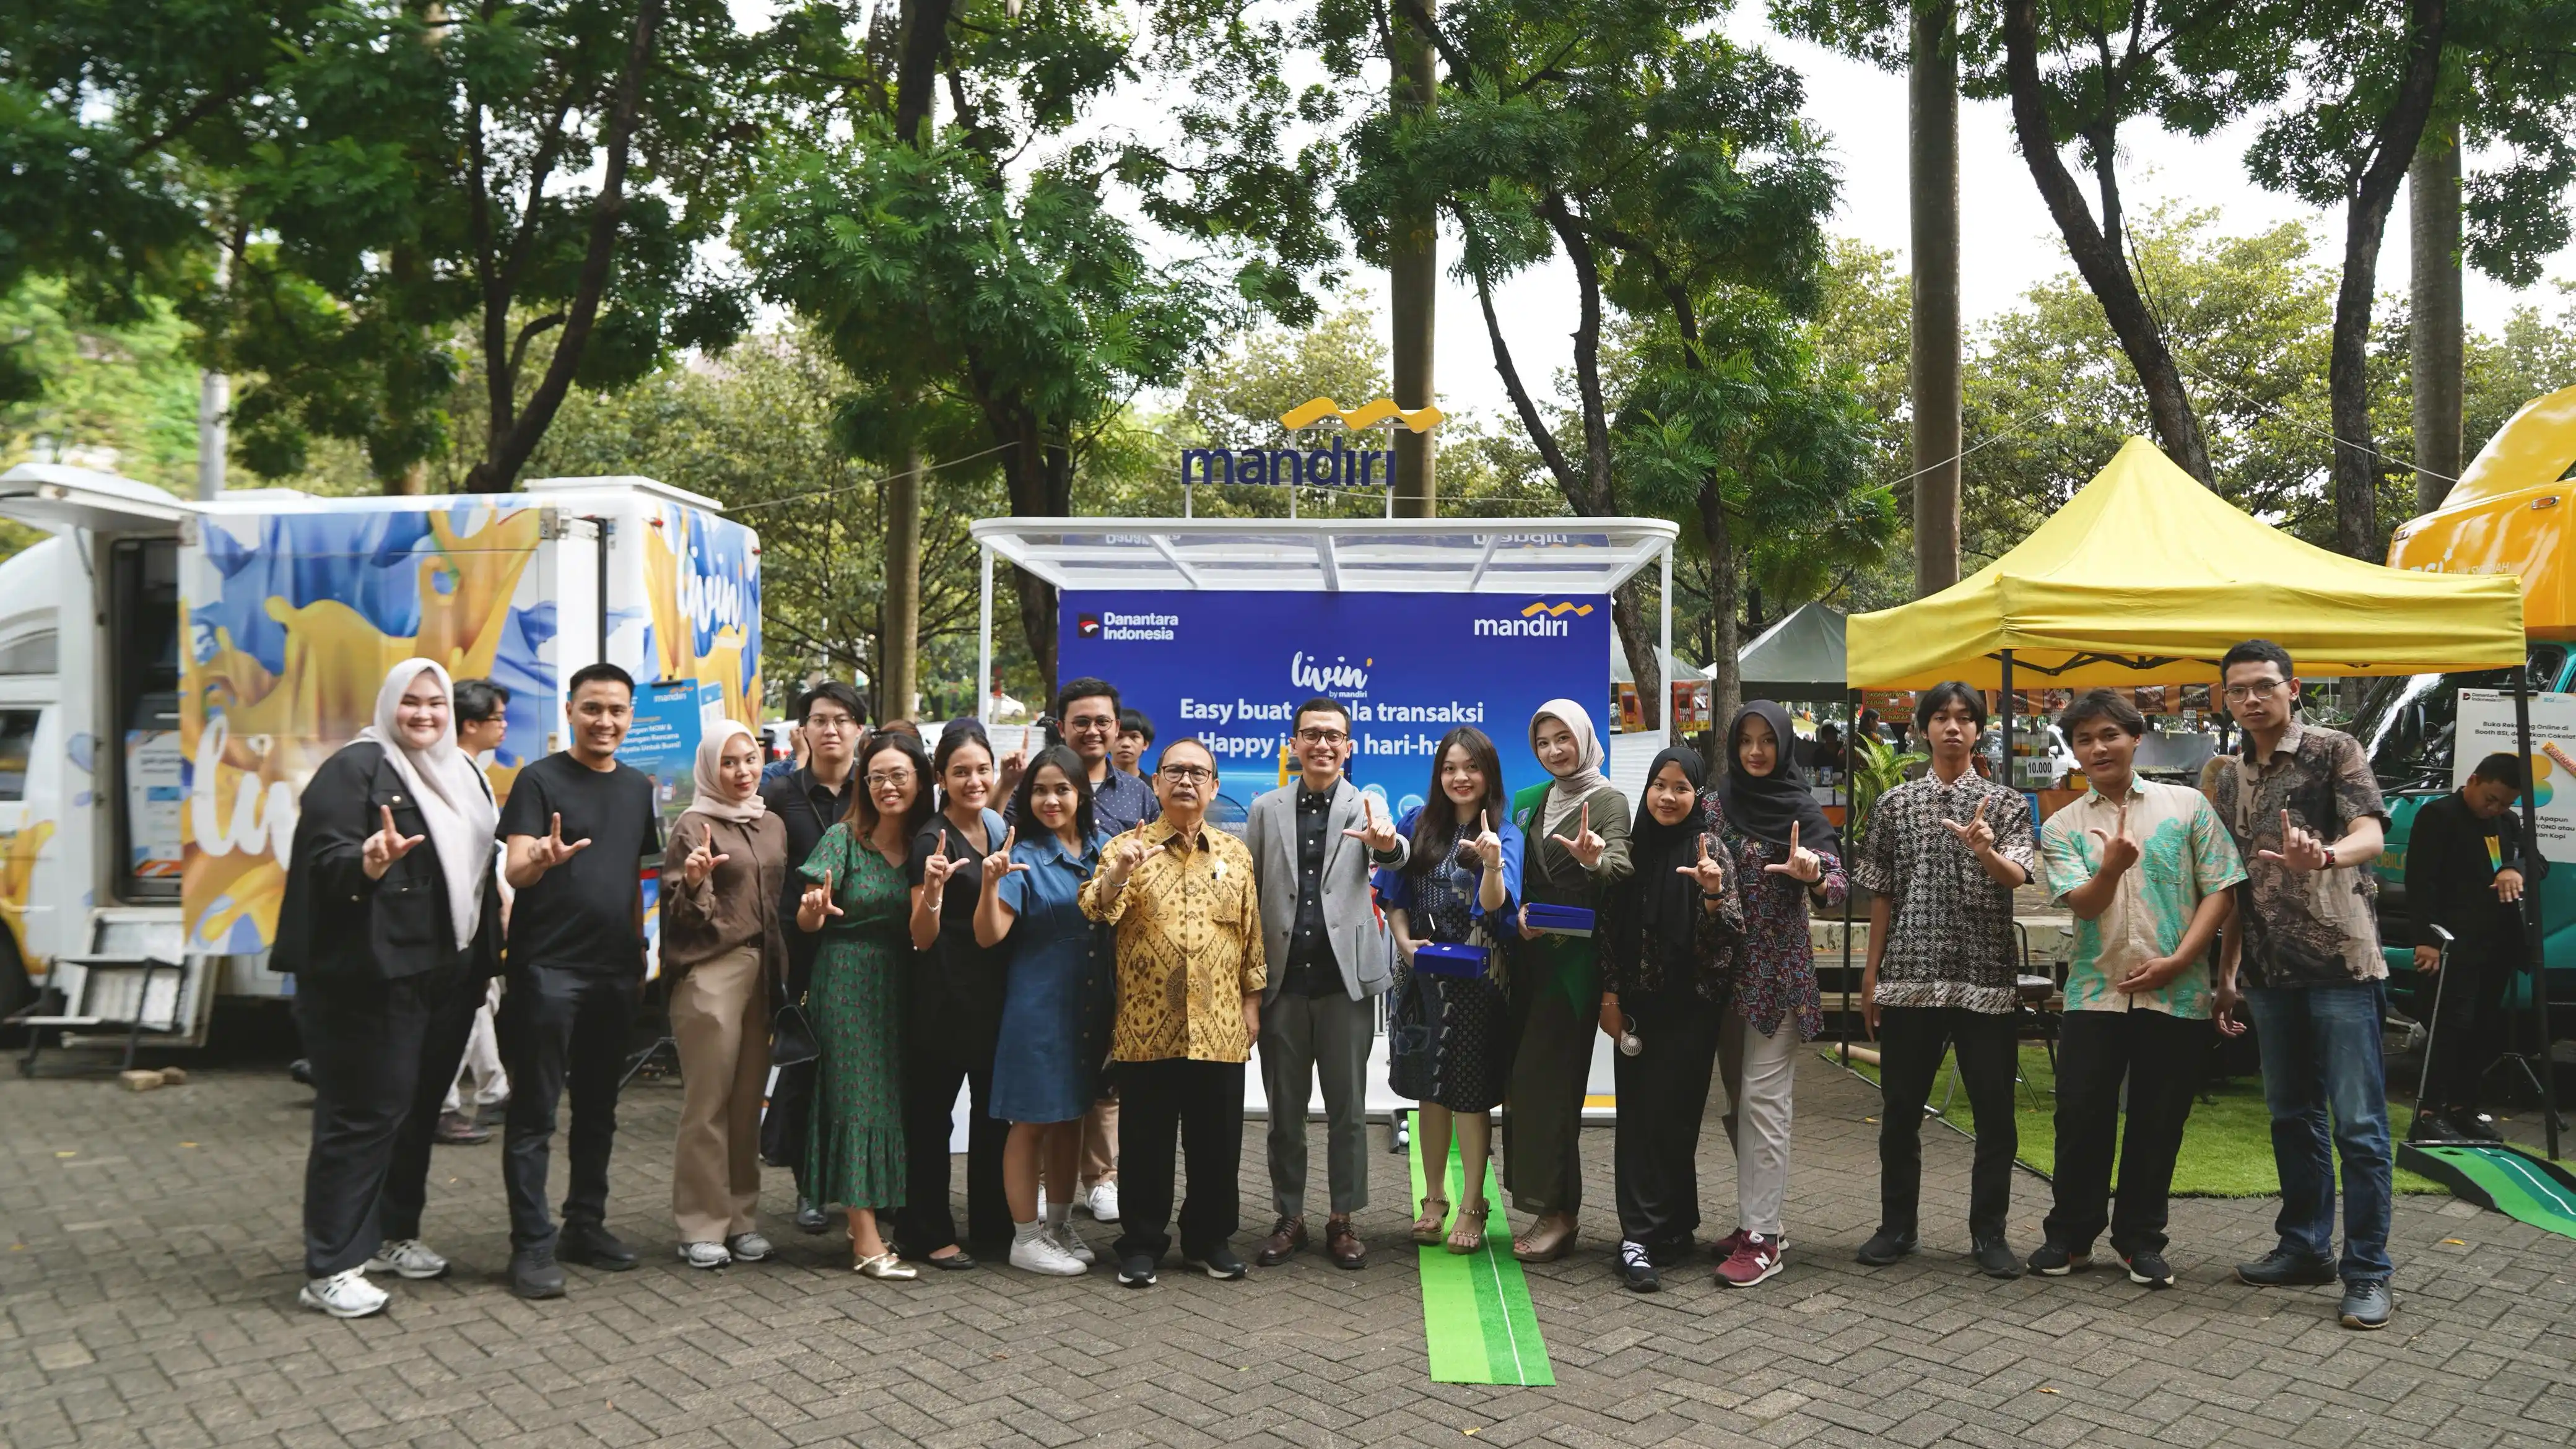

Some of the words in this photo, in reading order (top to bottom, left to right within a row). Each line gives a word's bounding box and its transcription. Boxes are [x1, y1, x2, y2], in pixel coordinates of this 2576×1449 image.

[1181, 436, 1396, 486] mandiri
[1103, 612, 1178, 625] Danantara
[1474, 614, 1567, 636] mandiri
[1103, 627, 1173, 640] Indonesia
[1329, 690, 1338, 698] by
[1180, 698, 1234, 725] Easy
[1238, 698, 1292, 720] buat
[1377, 701, 1483, 723] transaksi
[1198, 732, 1275, 759] Happy
[2028, 762, 2052, 773] 10.000
